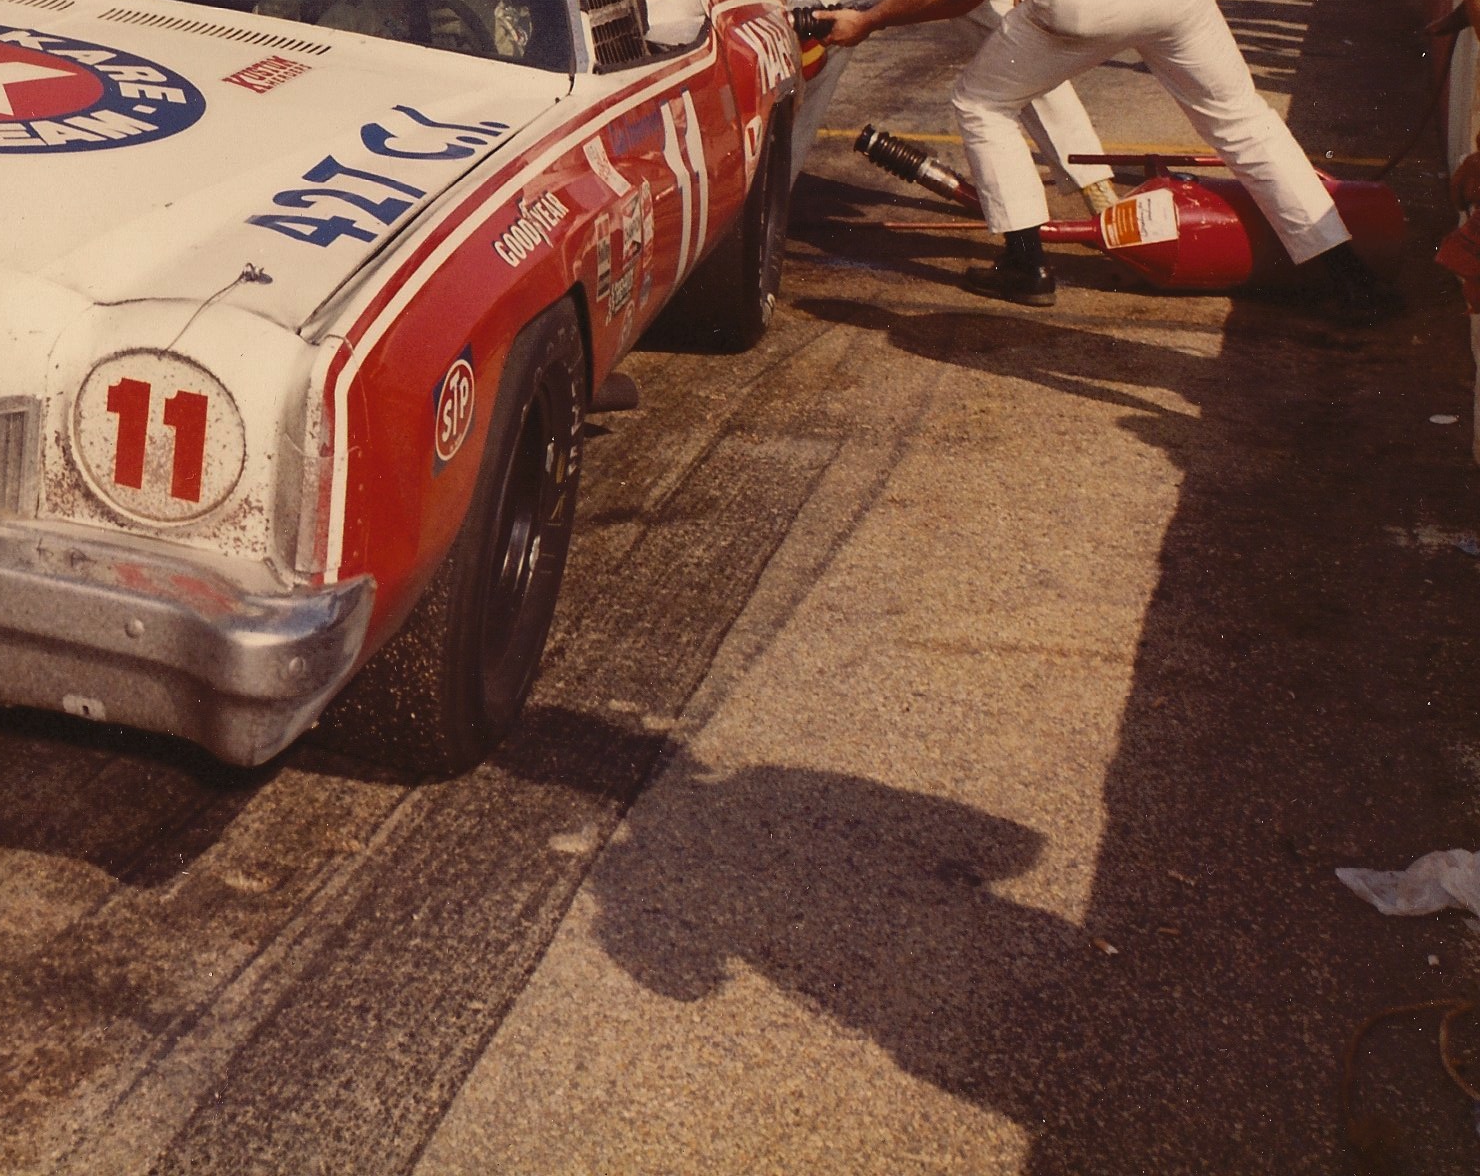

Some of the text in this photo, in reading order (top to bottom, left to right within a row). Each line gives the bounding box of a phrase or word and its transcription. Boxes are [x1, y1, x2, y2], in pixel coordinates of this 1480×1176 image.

[221, 55, 298, 94] KUSTOM
[244, 155, 427, 248] 427
[493, 191, 570, 268] GOODYEAR
[106, 377, 209, 503] 11
[441, 369, 470, 443] STP
